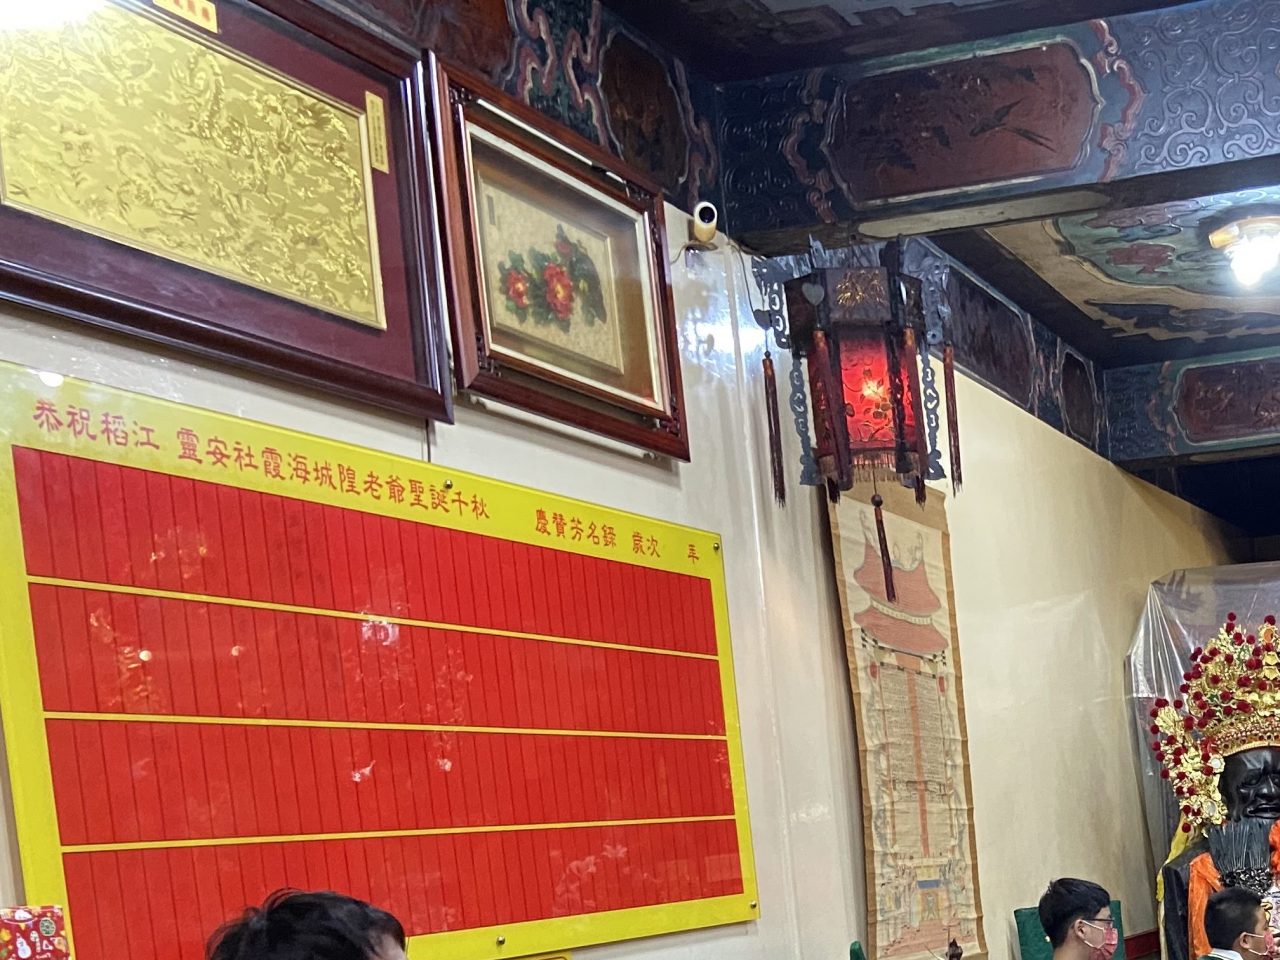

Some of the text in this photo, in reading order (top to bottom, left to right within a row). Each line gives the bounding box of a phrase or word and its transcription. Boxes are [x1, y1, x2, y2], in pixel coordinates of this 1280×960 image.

[32, 398, 160, 451] 恭祝稻江
[687, 543, 700, 565] 年
